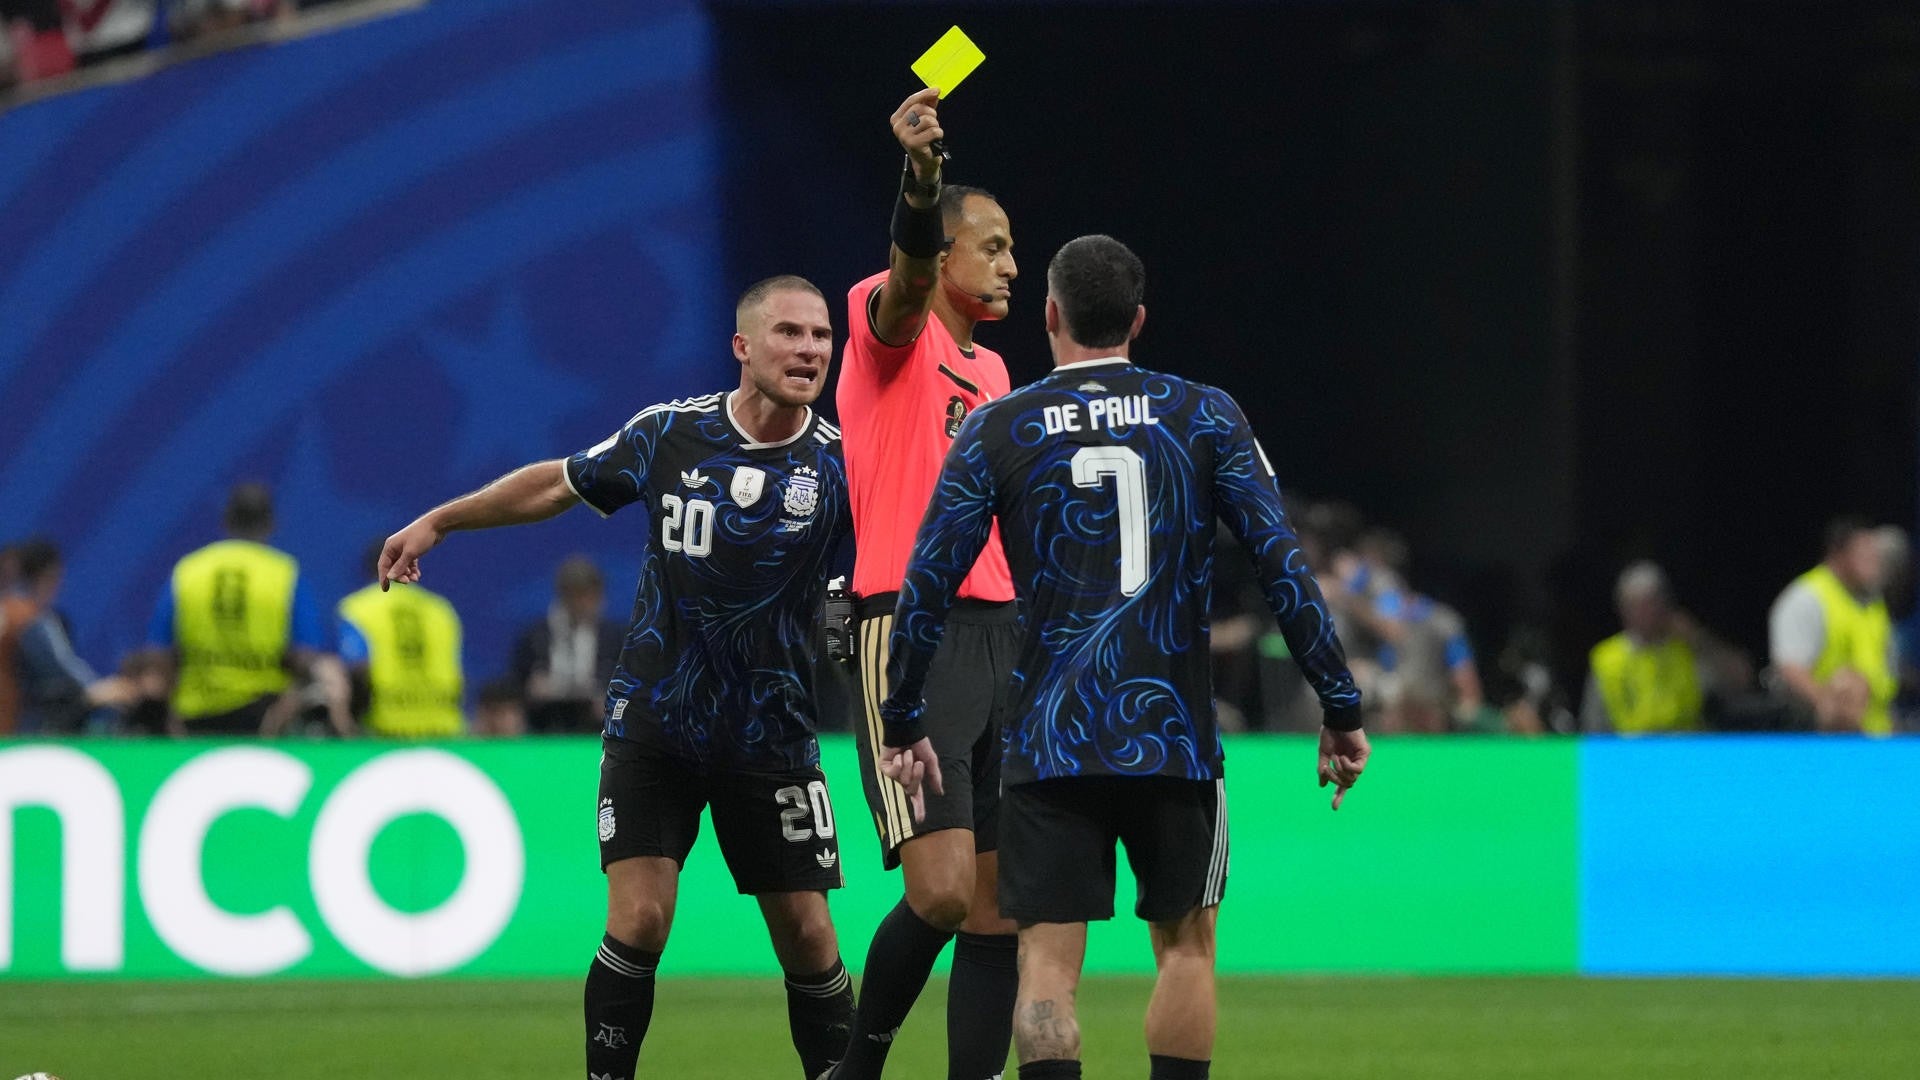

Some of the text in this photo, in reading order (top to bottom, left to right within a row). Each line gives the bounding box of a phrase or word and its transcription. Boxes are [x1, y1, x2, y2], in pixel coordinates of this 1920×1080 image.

[1043, 394, 1160, 435] DE PAUL
[661, 493, 715, 558] 20
[1070, 446, 1150, 597] 7
[774, 780, 835, 843] 20
[593, 1022, 628, 1049] AFA
